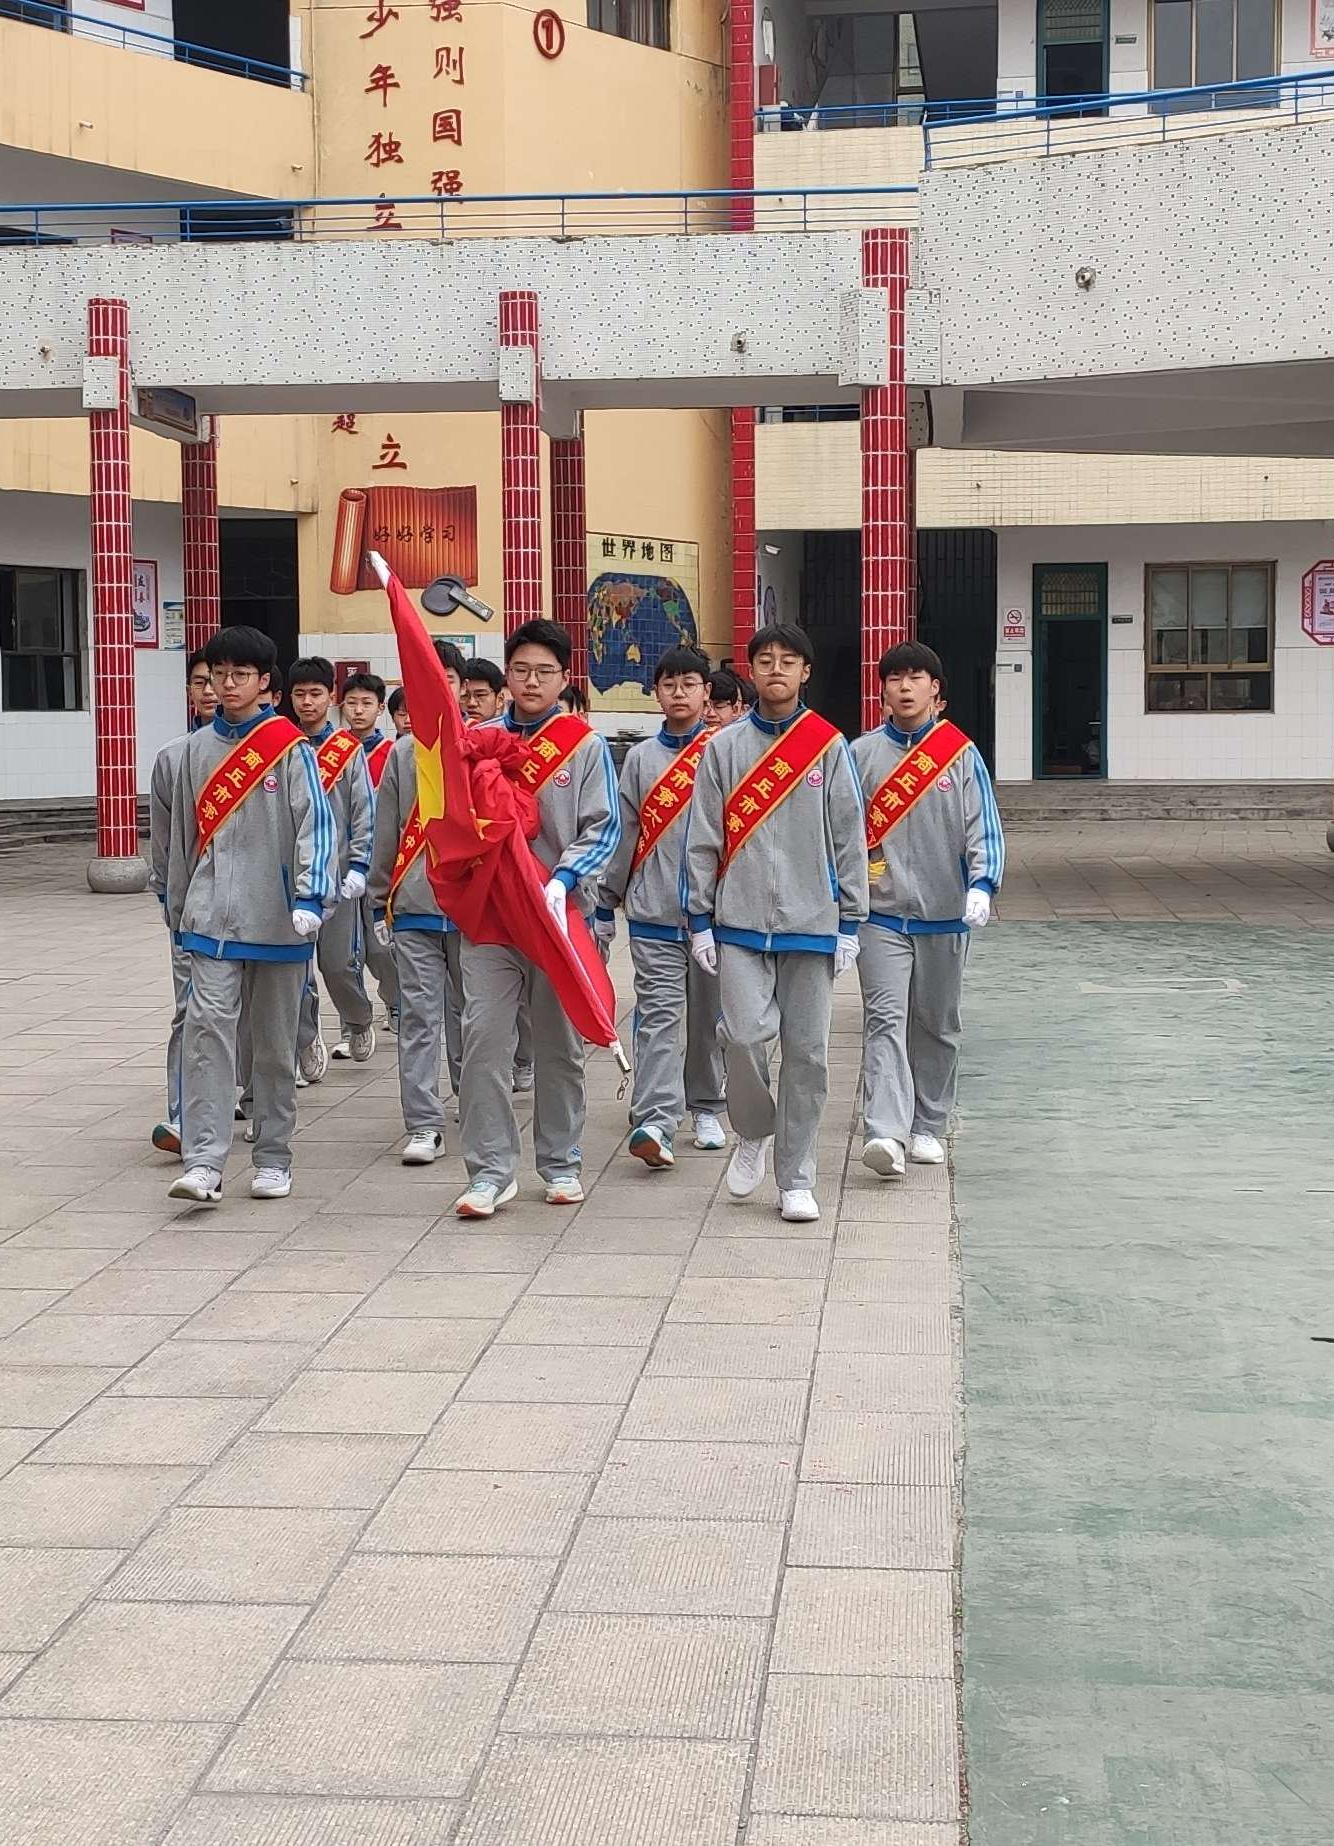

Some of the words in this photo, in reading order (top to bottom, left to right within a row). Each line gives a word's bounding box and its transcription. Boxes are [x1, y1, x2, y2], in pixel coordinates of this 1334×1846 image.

[359, 0, 404, 230] 少年独立
[331, 413, 359, 435] 超
[372, 433, 407, 470] 立
[373, 524, 456, 544] 好好学习
[602, 537, 674, 562] 世界地图
[515, 736, 562, 786] 商丘
